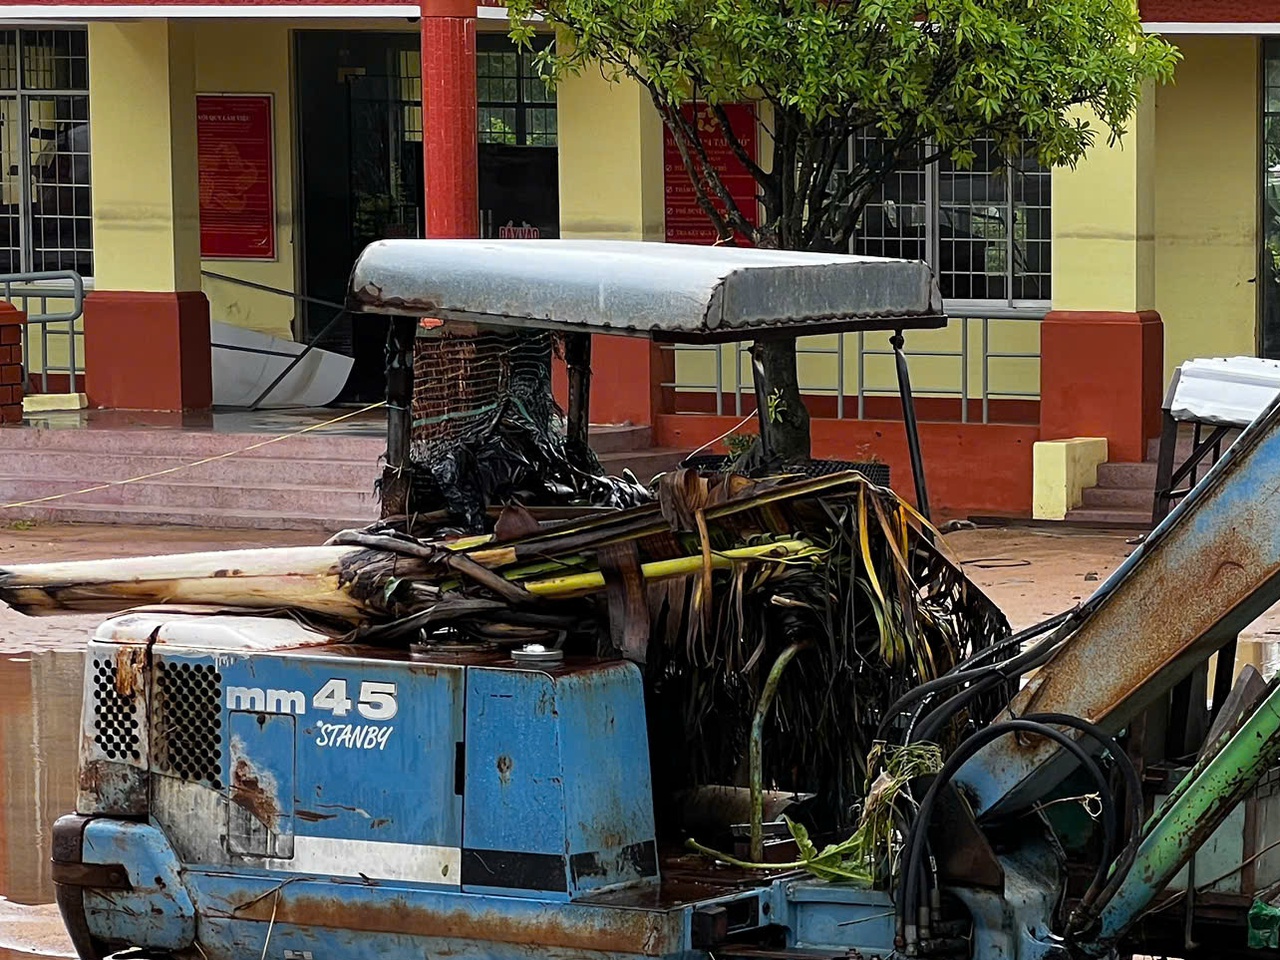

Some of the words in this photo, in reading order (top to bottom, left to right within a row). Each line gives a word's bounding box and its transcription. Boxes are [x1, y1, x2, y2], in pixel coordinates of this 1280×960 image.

[226, 686, 305, 715] mm
[312, 677, 398, 721] 45
[315, 723, 394, 751] STANBY
